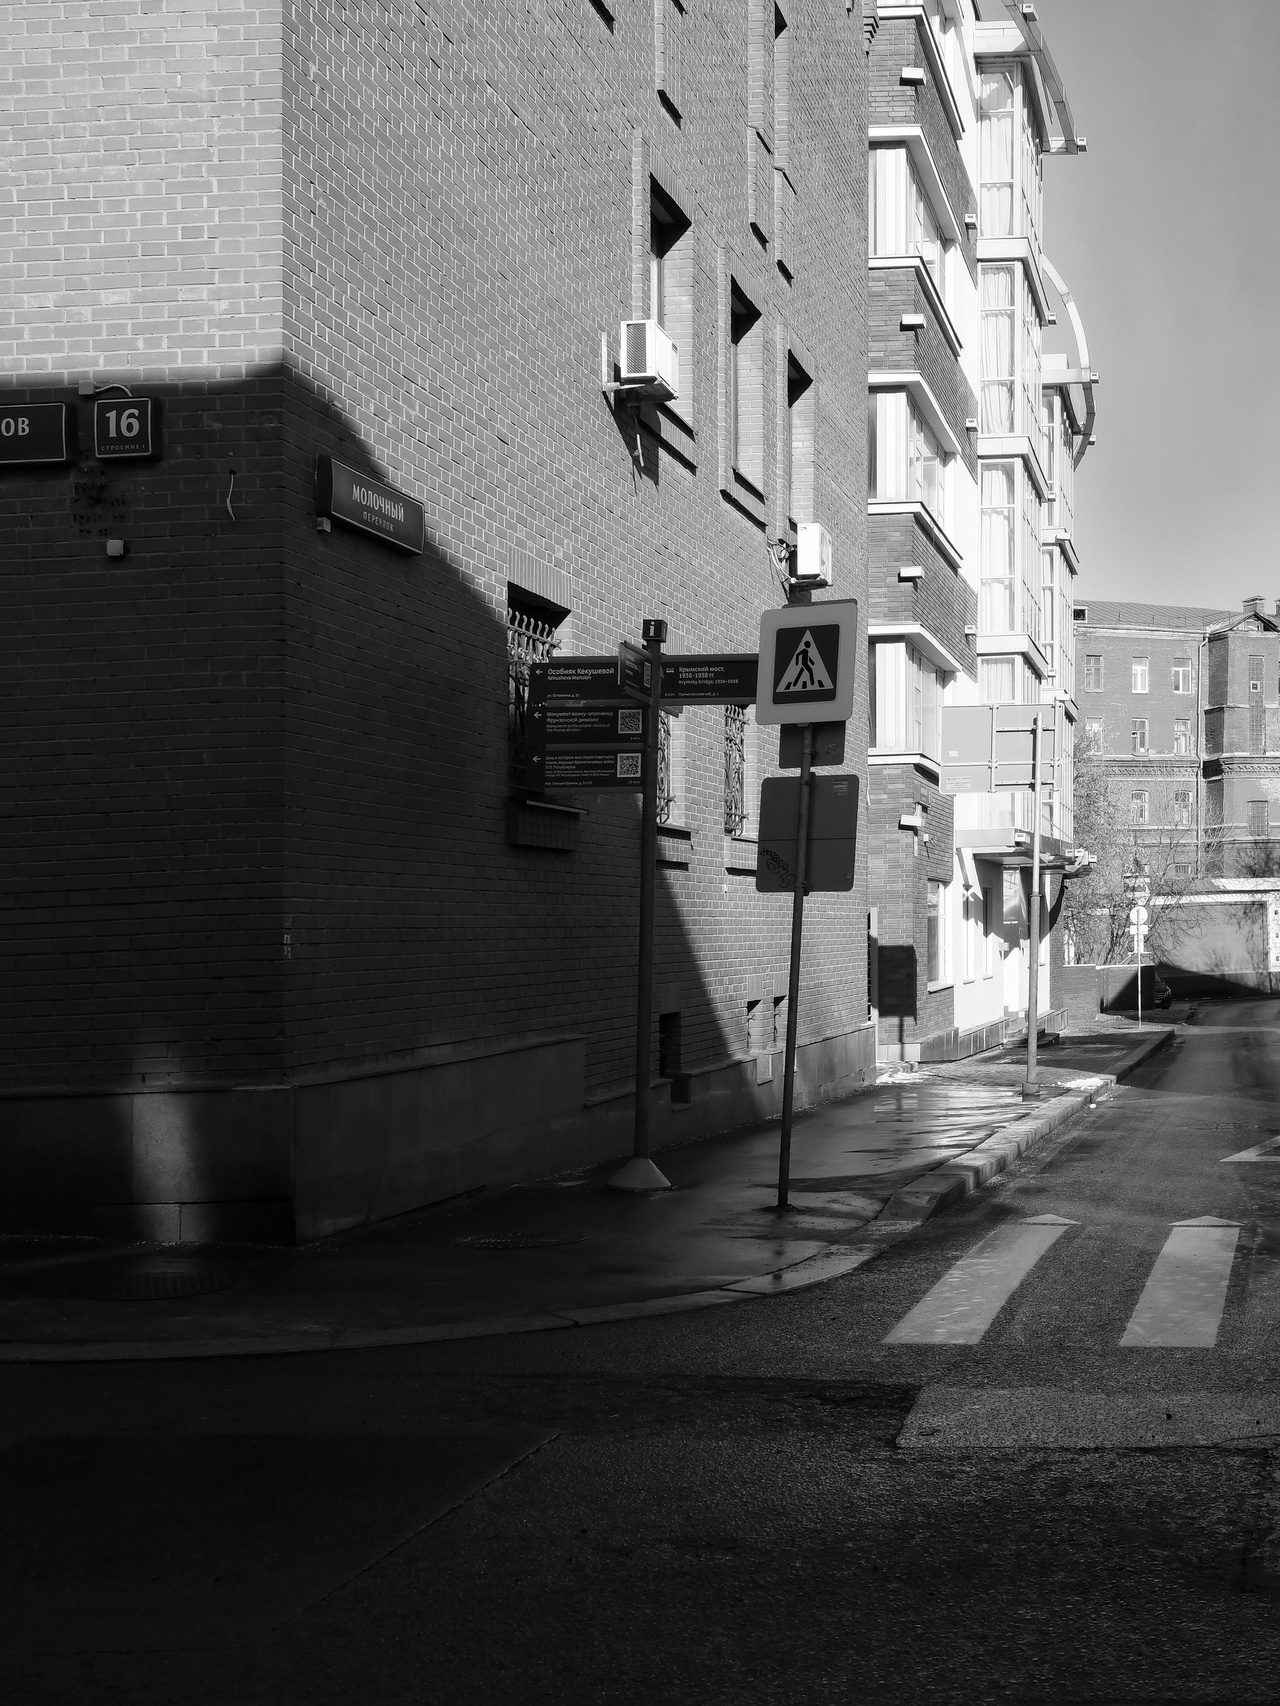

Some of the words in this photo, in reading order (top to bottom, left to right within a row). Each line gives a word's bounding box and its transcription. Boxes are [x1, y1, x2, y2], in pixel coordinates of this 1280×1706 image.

[0, 417, 30, 437] ОВ
[105, 408, 140, 438] 16
[352, 483, 404, 523] МОЛОЧНЫЙ
[363, 511, 394, 532] ПЕРЕУЛОК
[577, 667, 614, 676] Кекушевой
